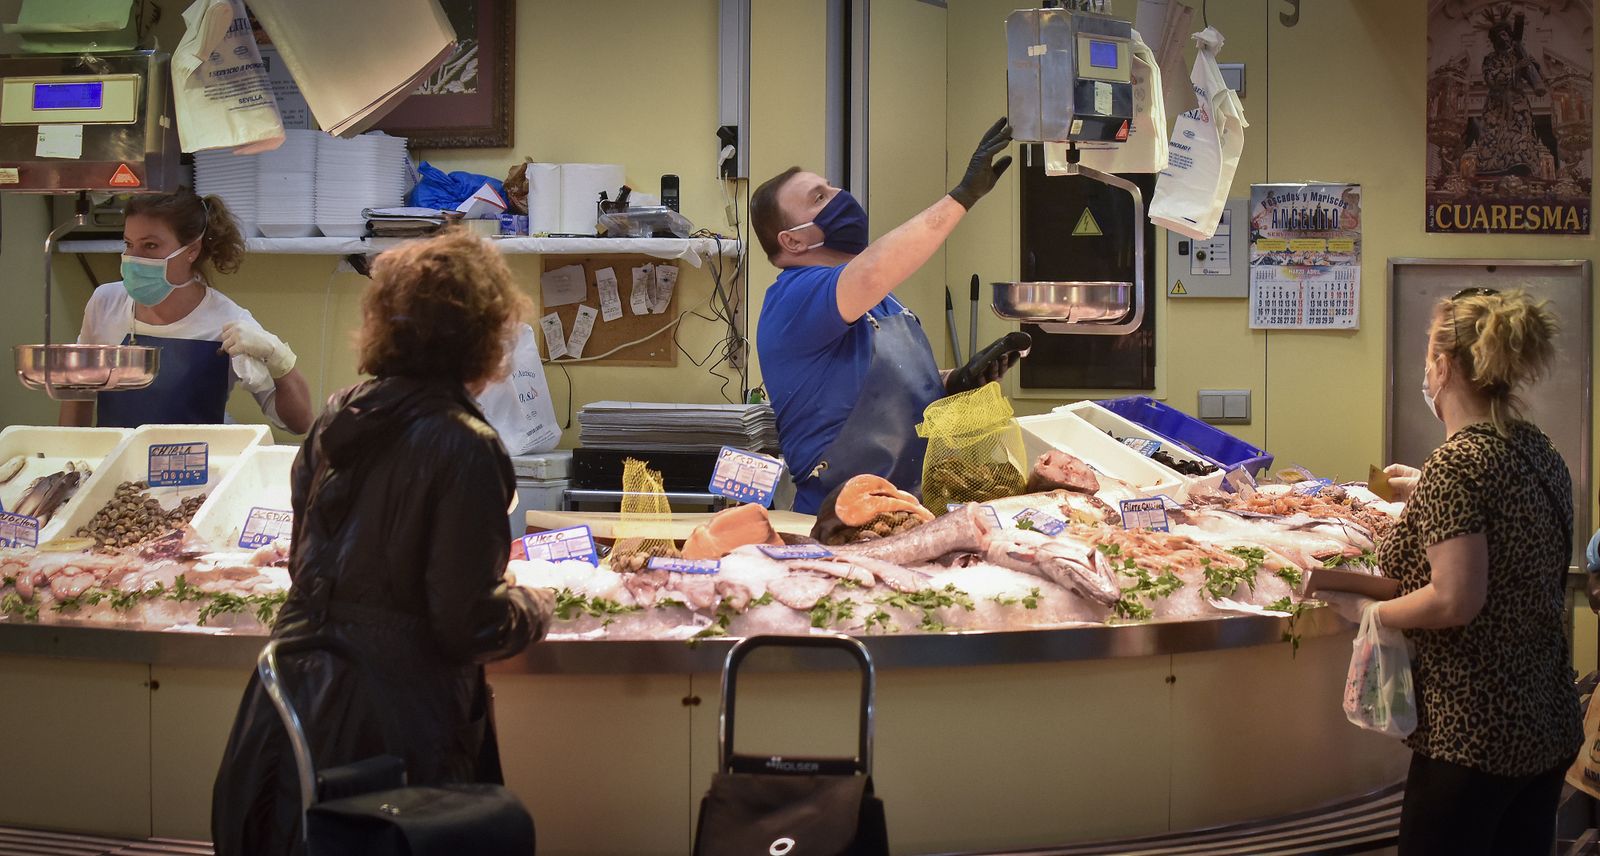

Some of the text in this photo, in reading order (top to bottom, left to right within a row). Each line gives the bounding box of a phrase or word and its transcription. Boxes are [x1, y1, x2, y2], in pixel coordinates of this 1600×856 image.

[239, 94, 263, 104] SEVILLA
[1261, 191, 1349, 210] Pescados y Mariscos
[1272, 208, 1339, 229] ANGELITO
[1435, 203, 1581, 230] CUARESMA
[1259, 291, 1263, 299] 2
[1266, 291, 1269, 299] 3
[1273, 291, 1276, 299] 4
[1279, 291, 1283, 299] 5
[1286, 291, 1290, 299] 6
[1292, 291, 1296, 299] 7
[1311, 291, 1315, 299] 6
[1317, 291, 1321, 299] 7
[1324, 291, 1328, 299] 8
[1343, 291, 1348, 299] 11
[1258, 308, 1264, 316] 16
[1265, 308, 1270, 316] 17
[1271, 308, 1277, 316] 18
[1278, 308, 1284, 316] 19
[1284, 308, 1291, 316] 20
[1291, 308, 1297, 316] 21
[1310, 308, 1316, 316] 20
[1316, 308, 1321, 316] 21
[1322, 308, 1328, 316] 22
[1335, 308, 1342, 316] 24
[1342, 308, 1348, 316] 25
